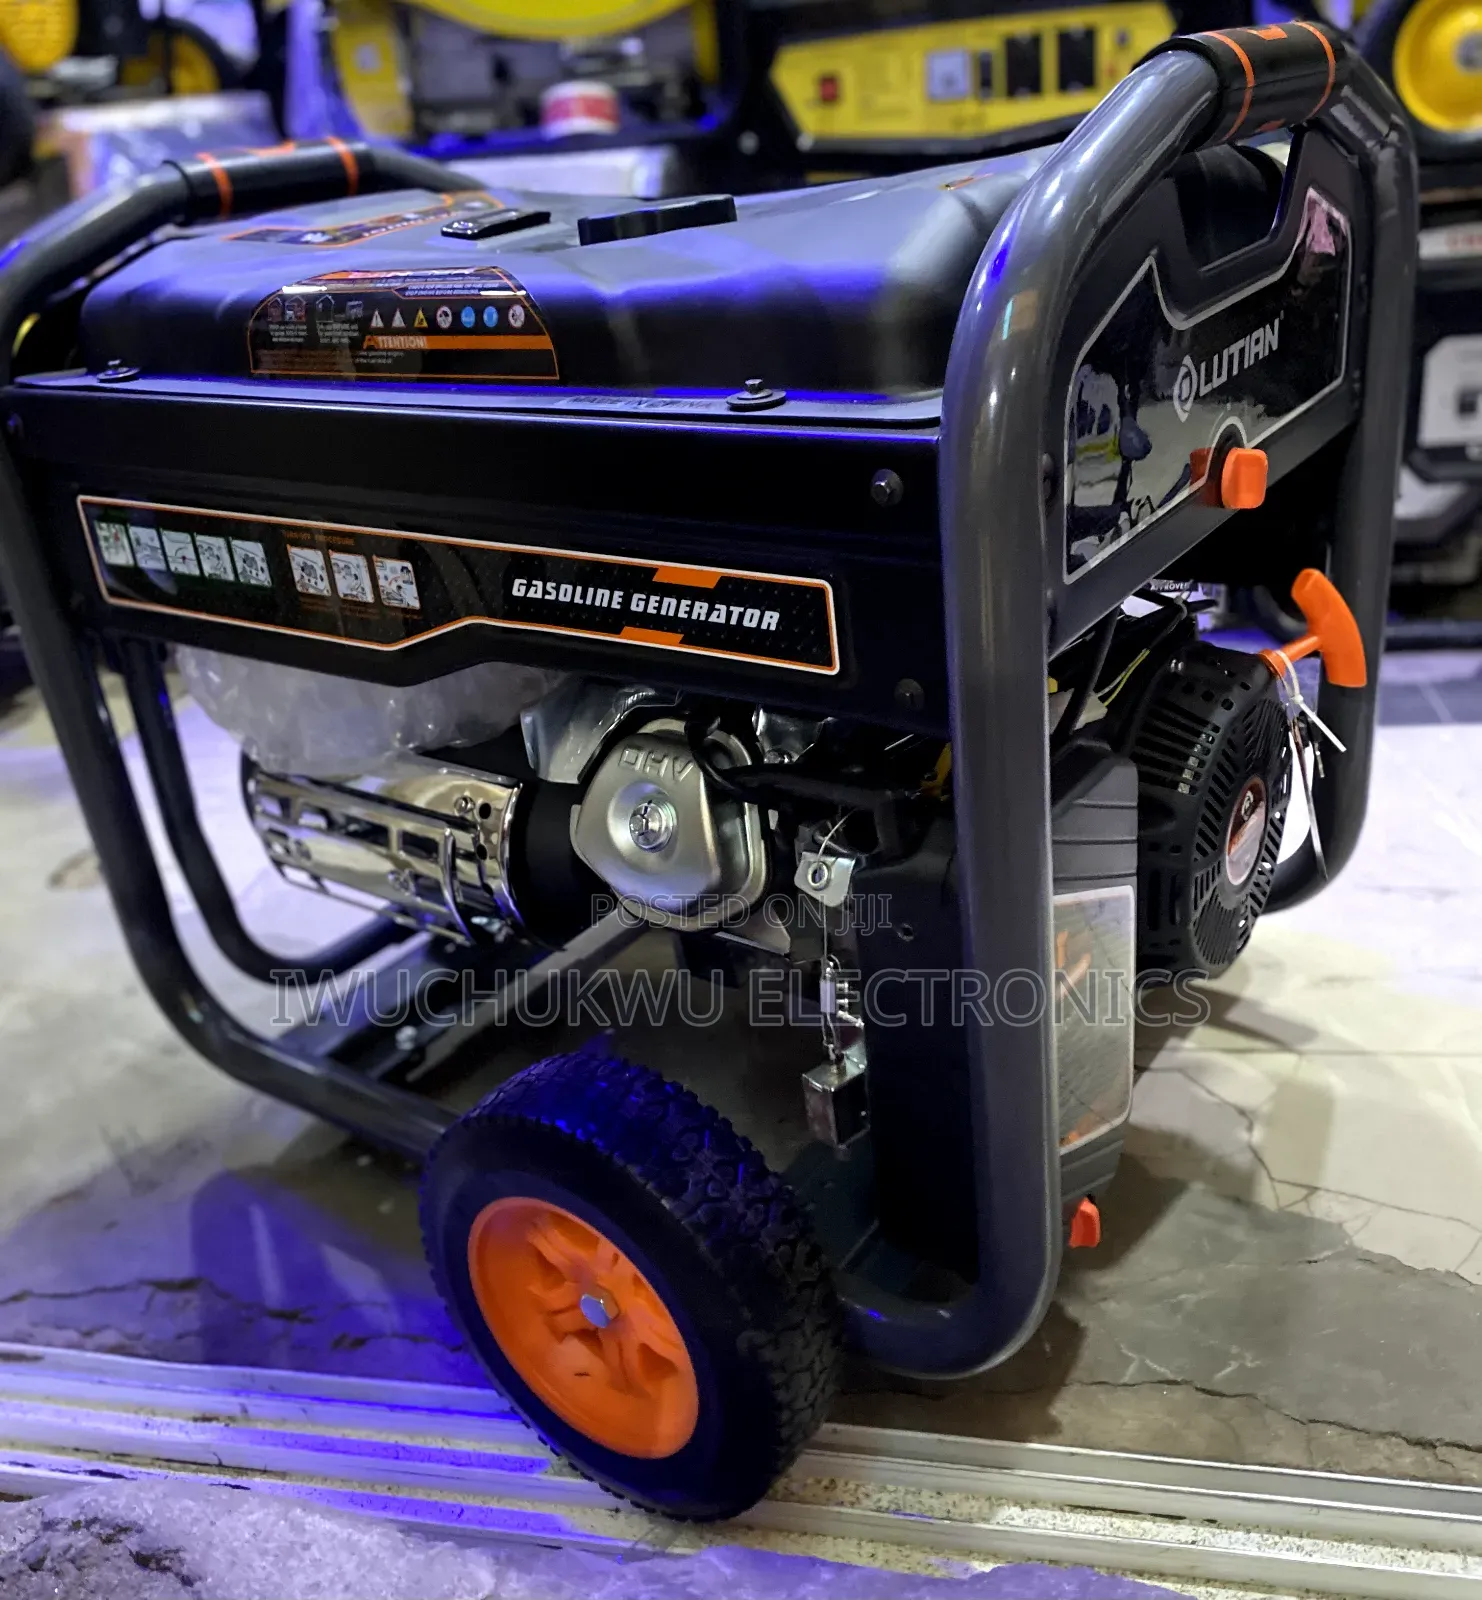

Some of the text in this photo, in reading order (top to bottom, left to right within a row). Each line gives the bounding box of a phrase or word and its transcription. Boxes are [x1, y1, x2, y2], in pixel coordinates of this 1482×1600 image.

[1199, 317, 1280, 397] LUTIAN
[511, 578, 780, 631] GASOLINE GENERATOR
[618, 745, 694, 783] OHV
